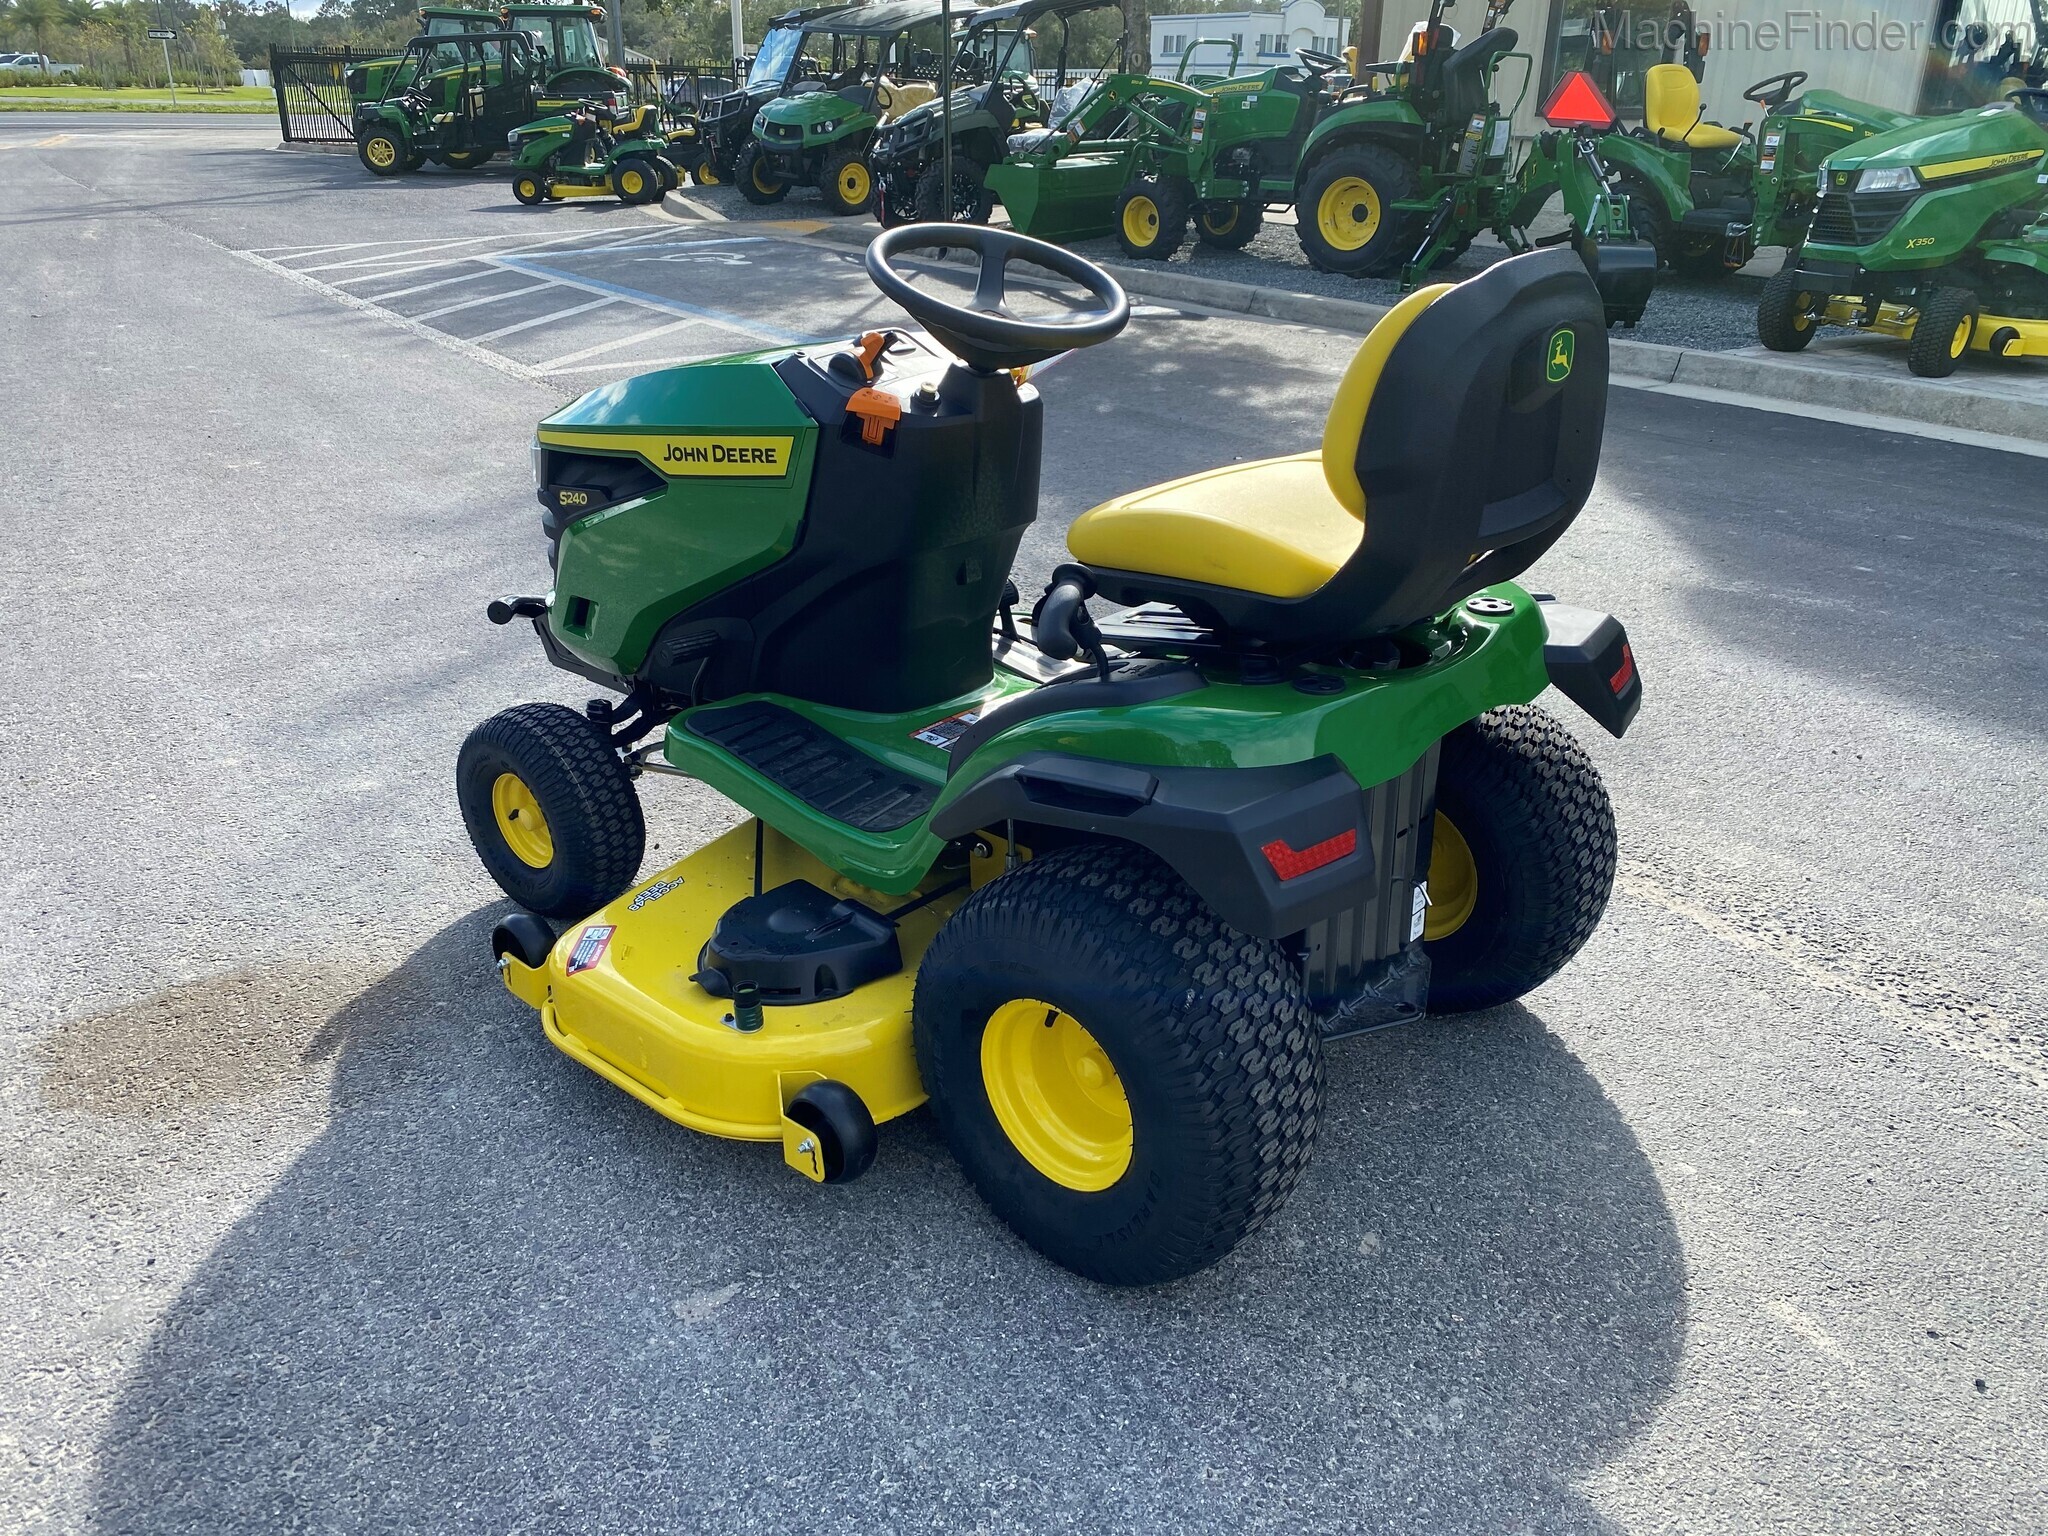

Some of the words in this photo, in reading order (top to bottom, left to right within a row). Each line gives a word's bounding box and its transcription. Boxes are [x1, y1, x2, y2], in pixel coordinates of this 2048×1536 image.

[1988, 157, 2008, 168] JOHN
[2008, 152, 2029, 163] DEERE
[1905, 237, 1935, 249] X350
[663, 444, 709, 463] JOHN
[712, 444, 777, 464] DEERE
[559, 490, 588, 506] S240
[650, 876, 685, 901] ACCEL
